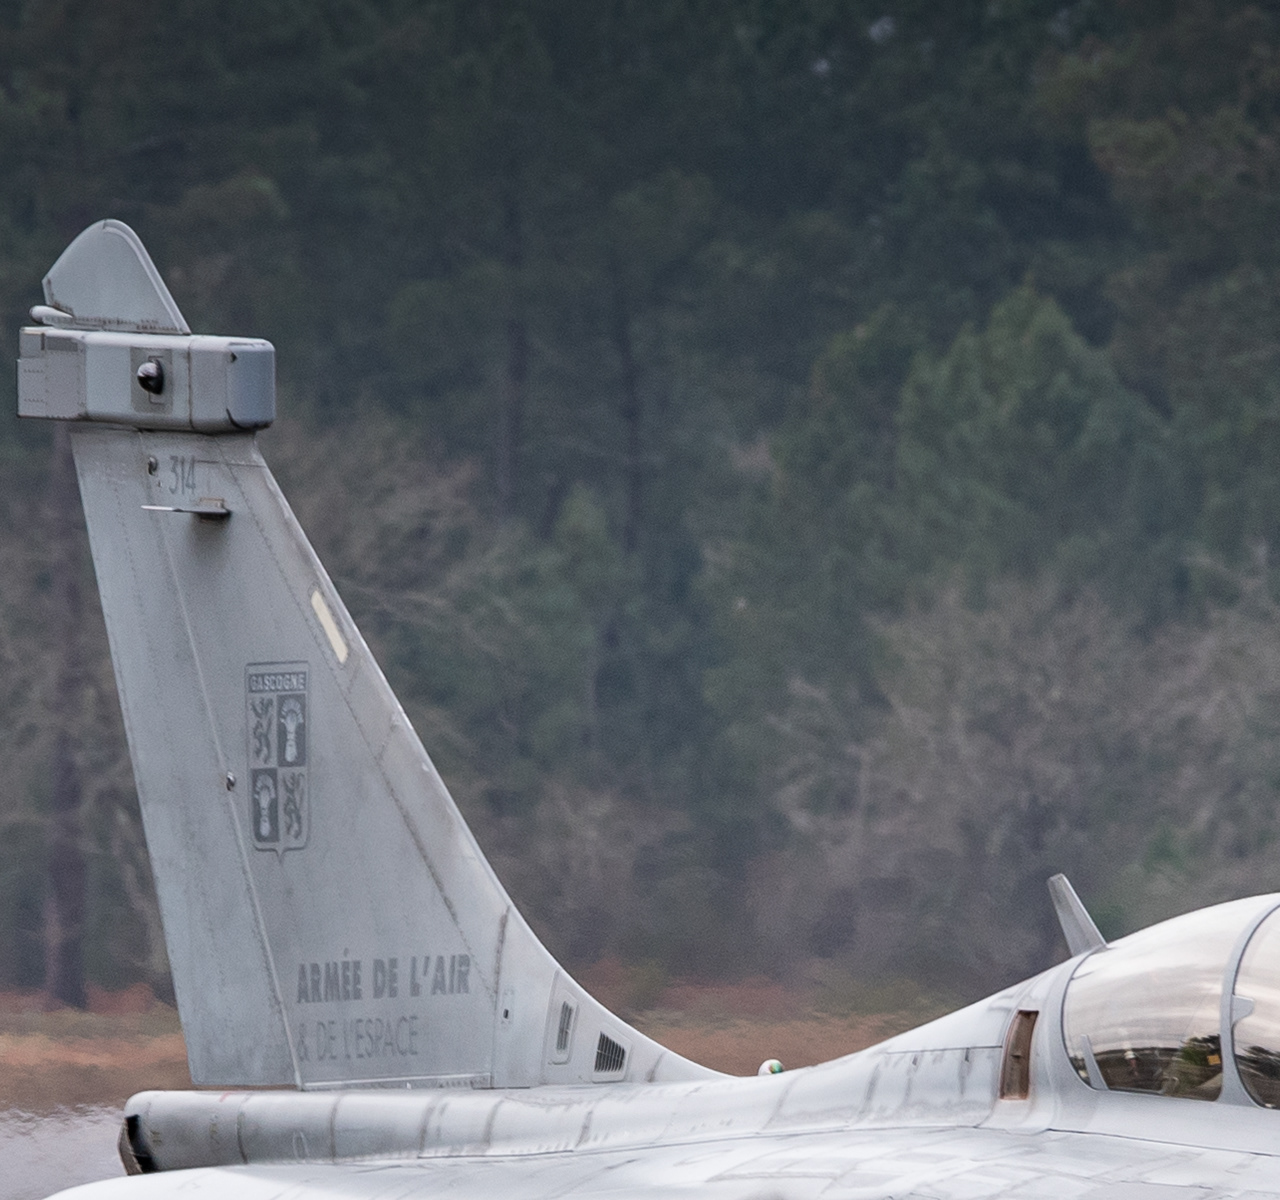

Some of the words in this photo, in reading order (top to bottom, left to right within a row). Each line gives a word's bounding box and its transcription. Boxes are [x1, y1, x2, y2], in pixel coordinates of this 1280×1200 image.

[169, 455, 196, 495] 314
[249, 674, 305, 690] GASCOGNE
[297, 947, 362, 1003] ARMÉE
[372, 958, 398, 999] DE
[410, 954, 470, 997] L'AIR
[317, 1019, 337, 1061] DE
[343, 1014, 418, 1060] L'ESPACE
